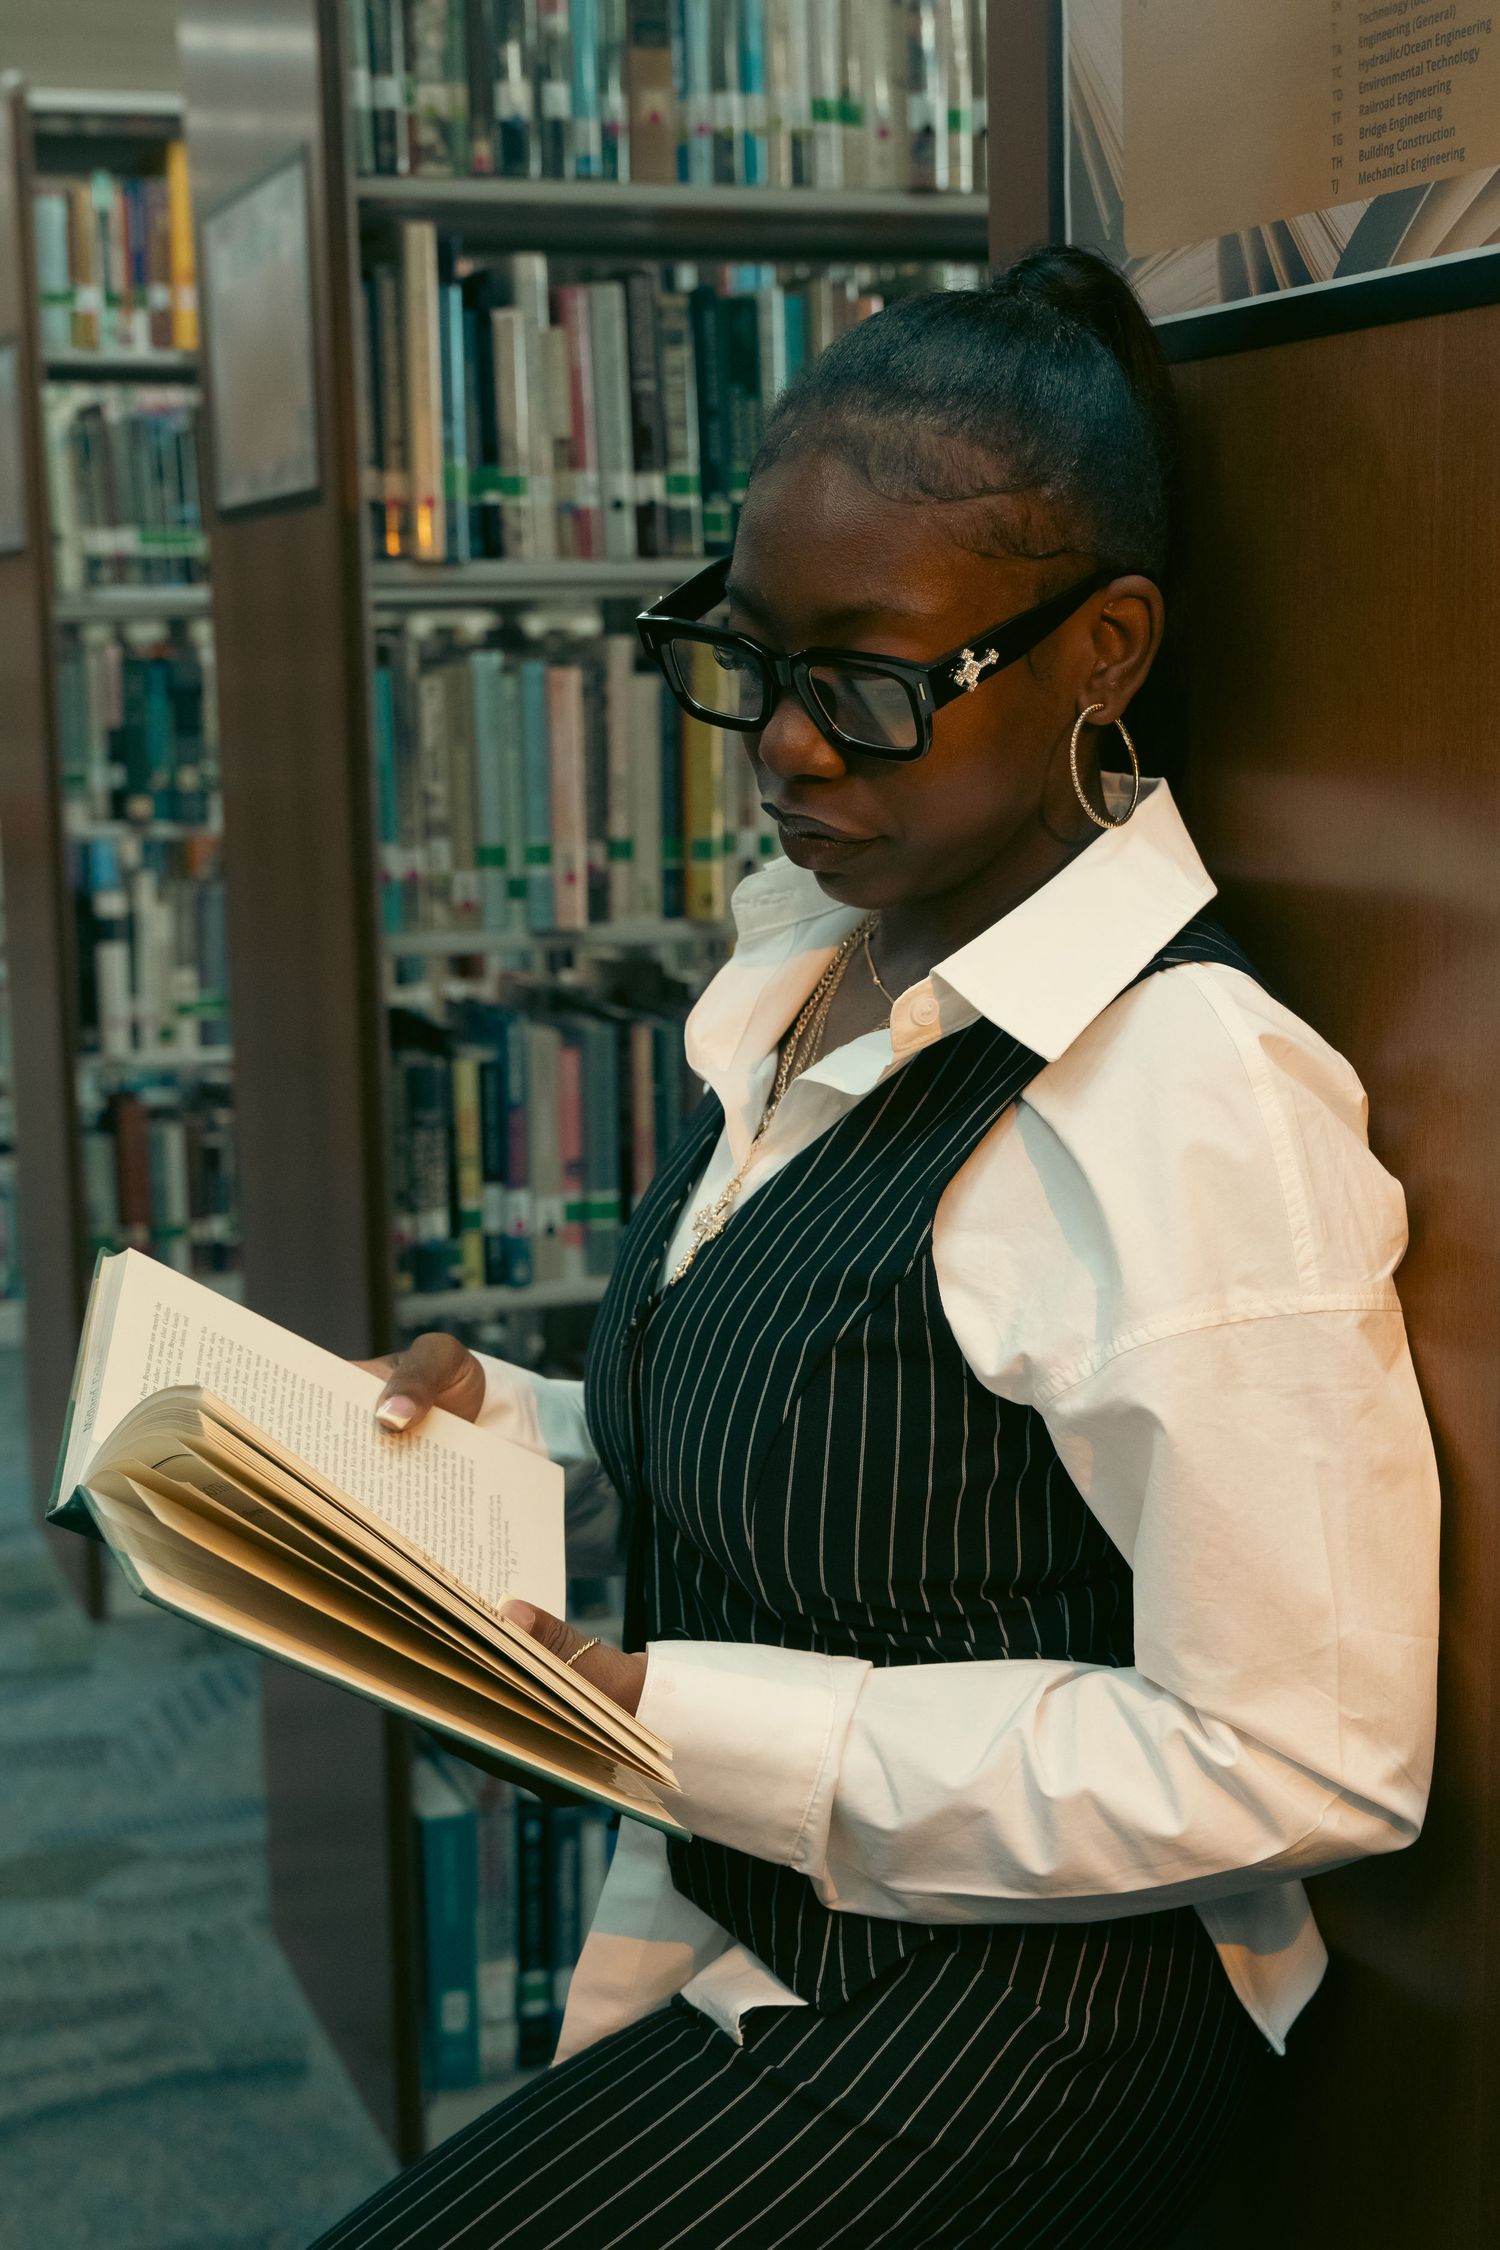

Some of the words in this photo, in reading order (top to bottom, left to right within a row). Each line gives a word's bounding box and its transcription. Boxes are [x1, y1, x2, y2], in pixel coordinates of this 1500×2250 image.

[1358, 0, 1408, 25] Technology
[1358, 21, 1410, 48] Engineering
[1412, 4, 1456, 33] (General)
[1358, 38, 1432, 72] Hydraulic/Ocean
[1435, 18, 1492, 47] Engineering
[1331, 66, 1342, 79] TC
[1359, 63, 1423, 94] Environmental
[1426, 47, 1480, 72] Technology
[1359, 94, 1395, 116] Railroad
[1397, 79, 1452, 106] Engineering
[1332, 133, 1343, 146] TG
[1359, 119, 1388, 140] Bridge
[1389, 105, 1443, 131] Engineering
[1359, 141, 1395, 162] Building
[1396, 126, 1456, 151] Construction
[1332, 157, 1342, 170] TH
[1358, 161, 1409, 185] Mechanical
[1411, 146, 1466, 176] Engineering
[1331, 179, 1340, 194] TJ
[81, 1390, 98, 1432] Midland
